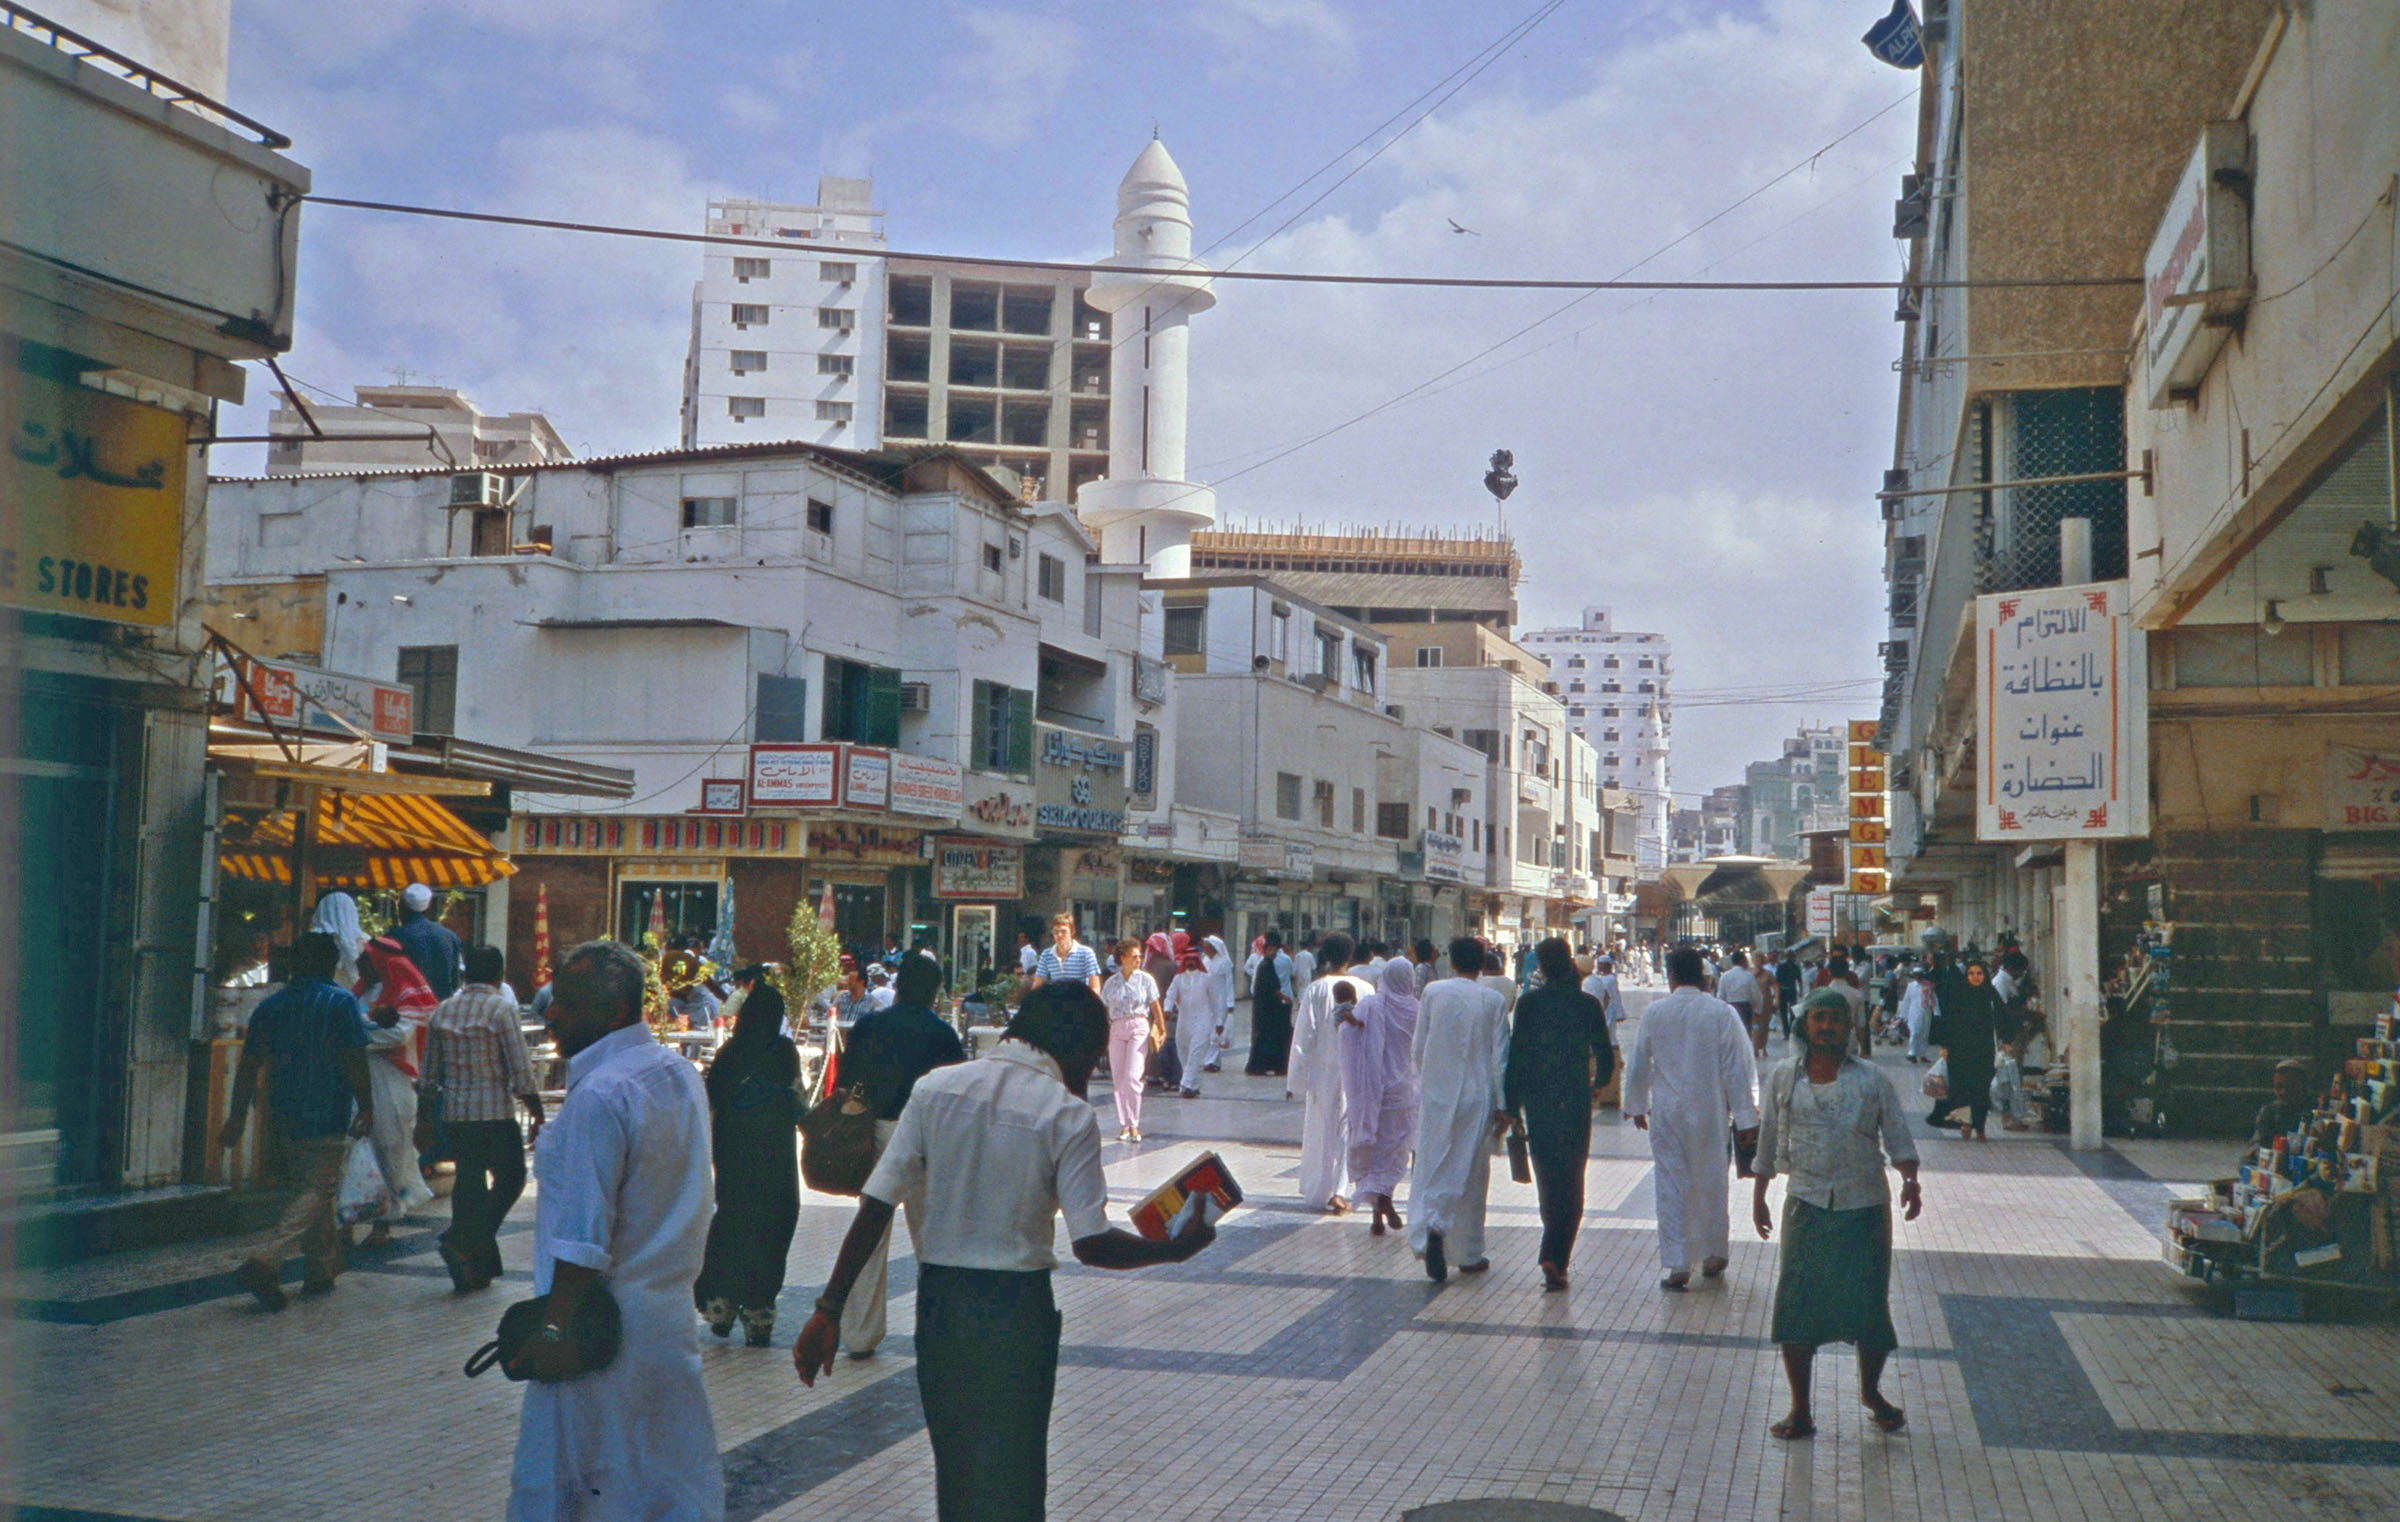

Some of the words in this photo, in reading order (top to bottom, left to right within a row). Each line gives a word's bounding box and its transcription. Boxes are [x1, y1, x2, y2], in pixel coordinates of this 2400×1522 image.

[38, 556, 148, 609] STORES
[2017, 607, 2087, 649] الالتزام
[2003, 653, 2103, 697] بالنظافة
[2020, 712, 2084, 746] عنوان
[1083, 741, 1125, 775] سيكو
[1136, 734, 1151, 792] SEIKO
[2001, 752, 2103, 798] الحضارة
[1036, 803, 1080, 828] SEIKO
[1856, 722, 1878, 892] GLEMGAS
[2344, 806, 2387, 824] BIG
